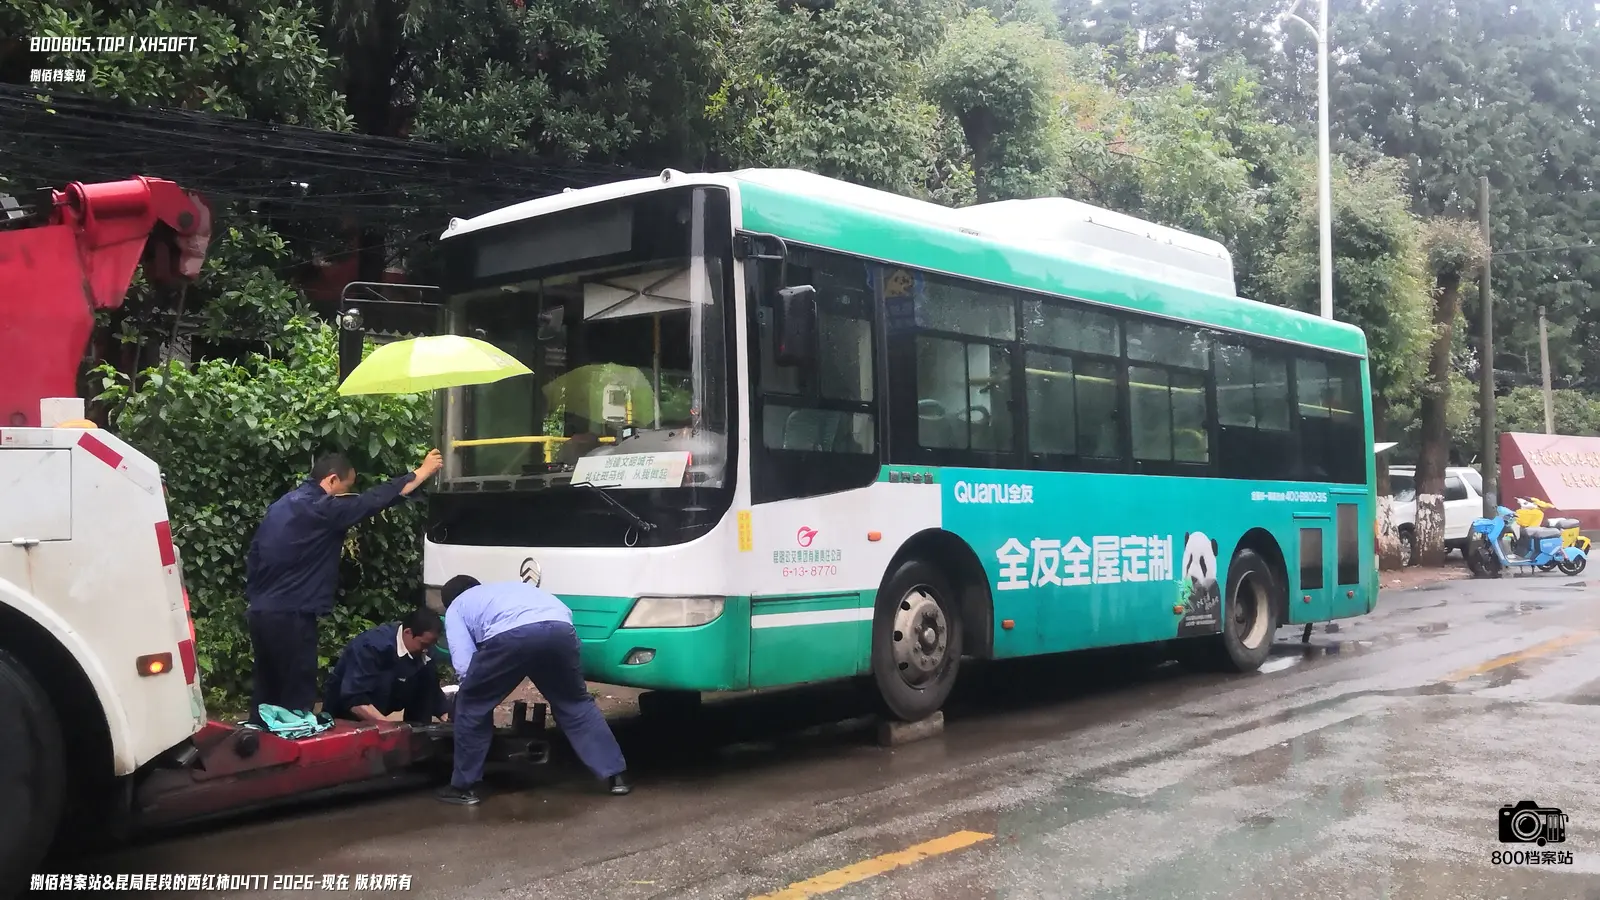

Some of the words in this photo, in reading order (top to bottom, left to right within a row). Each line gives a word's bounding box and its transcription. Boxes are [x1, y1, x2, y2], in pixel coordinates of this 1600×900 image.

[604, 455, 654, 468] 创建文明城市
[996, 534, 1173, 590] 全友全屋定制
